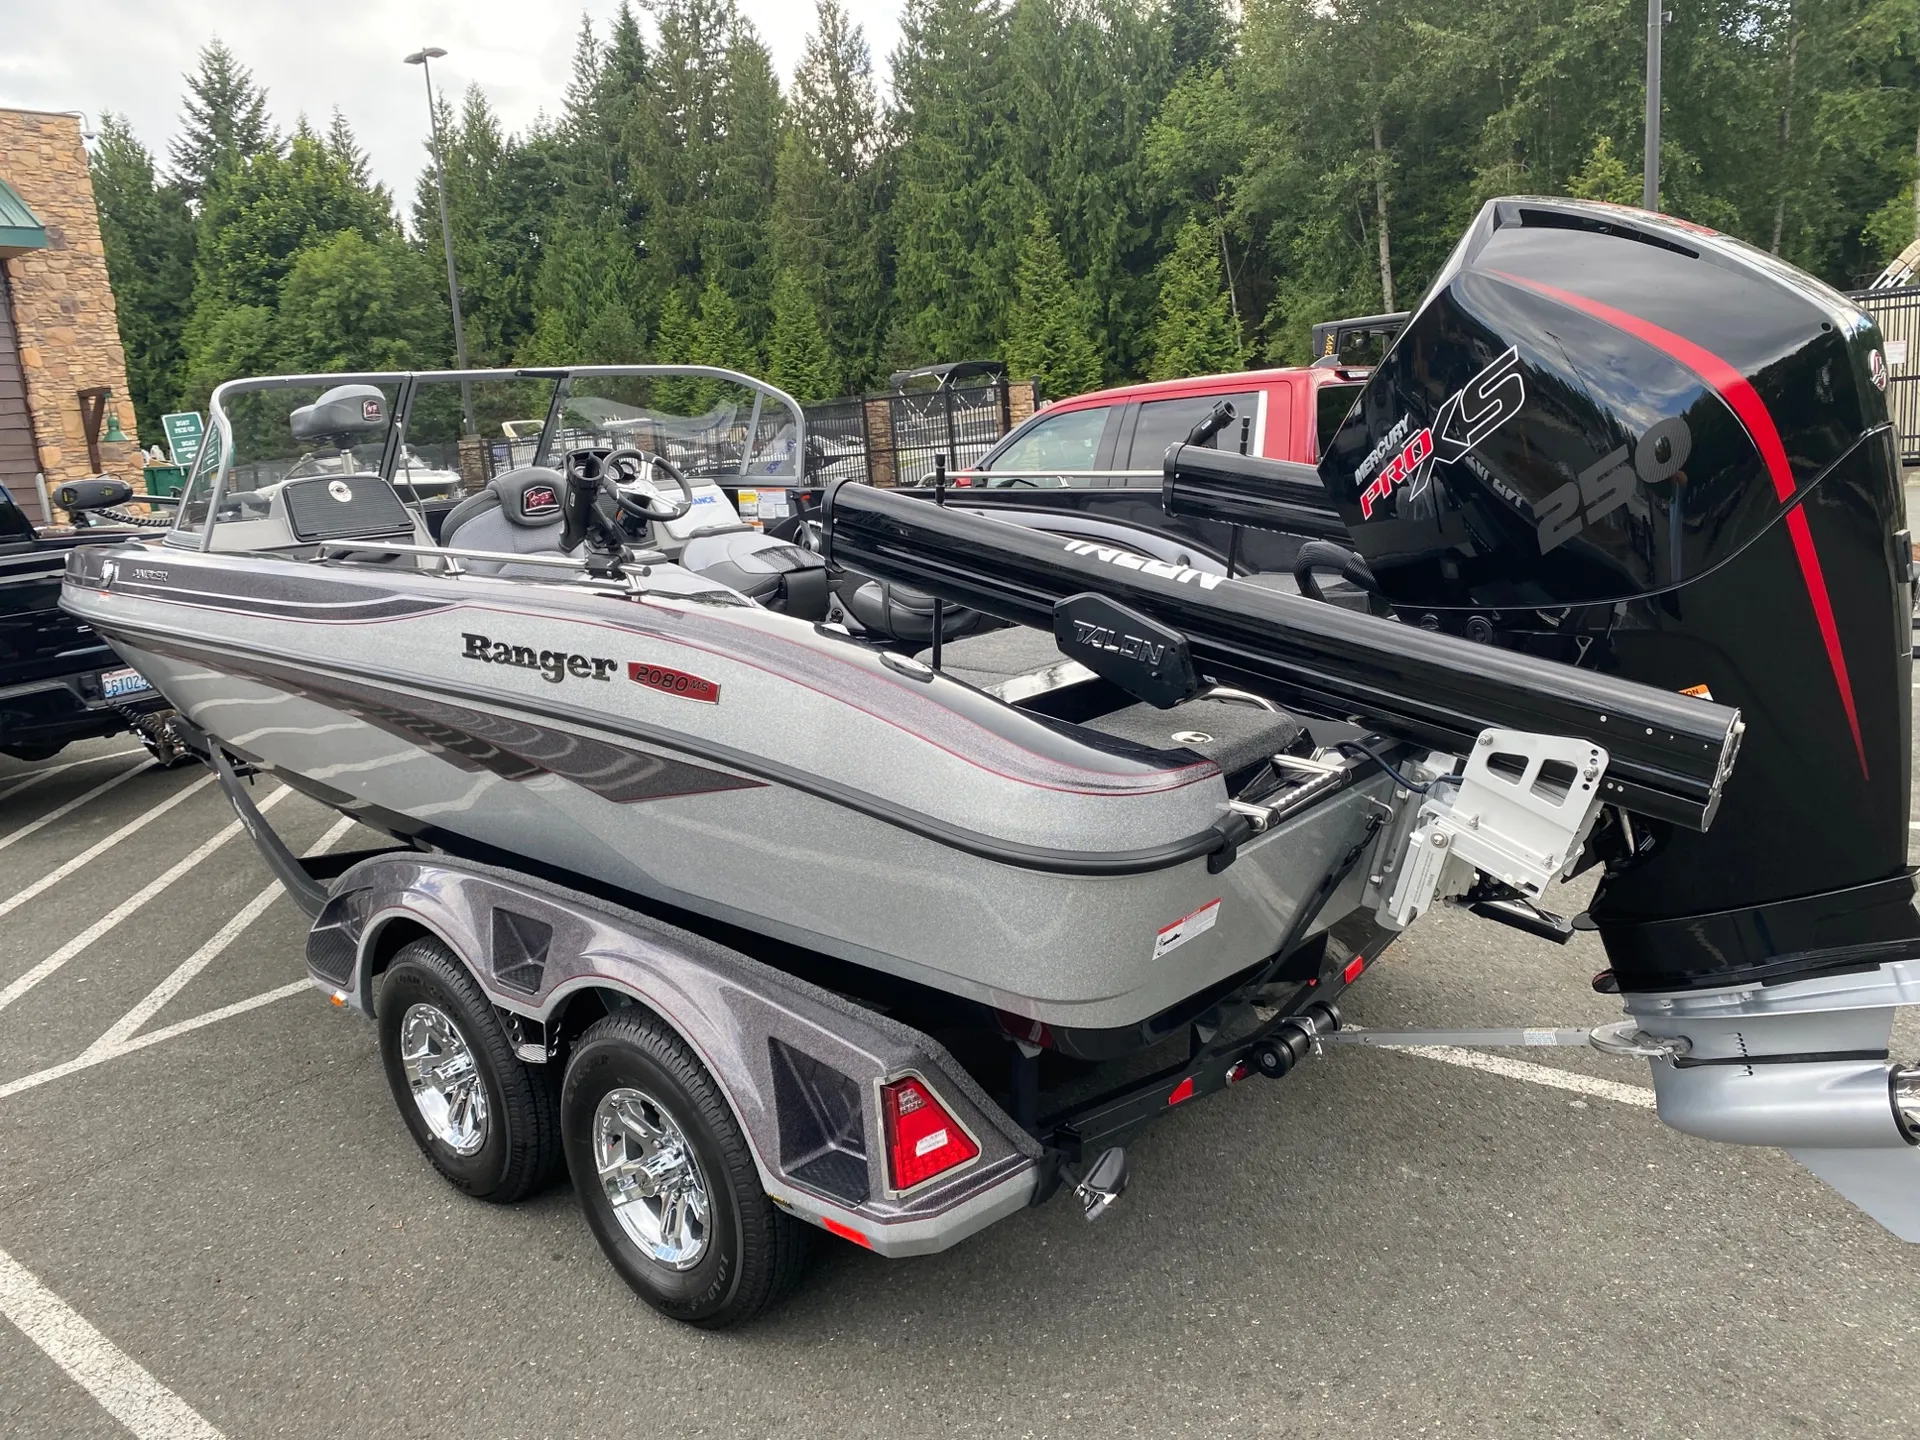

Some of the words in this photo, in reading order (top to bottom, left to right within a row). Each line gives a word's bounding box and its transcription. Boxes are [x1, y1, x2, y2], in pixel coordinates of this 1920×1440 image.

[1354, 413, 1409, 487] MERCURY
[1360, 427, 1434, 520] PRO
[1408, 345, 1525, 502] XS
[1533, 417, 1692, 555] 250
[461, 632, 618, 683] Ranger
[1073, 620, 1165, 666] TALON
[636, 664, 688, 692] 2080
